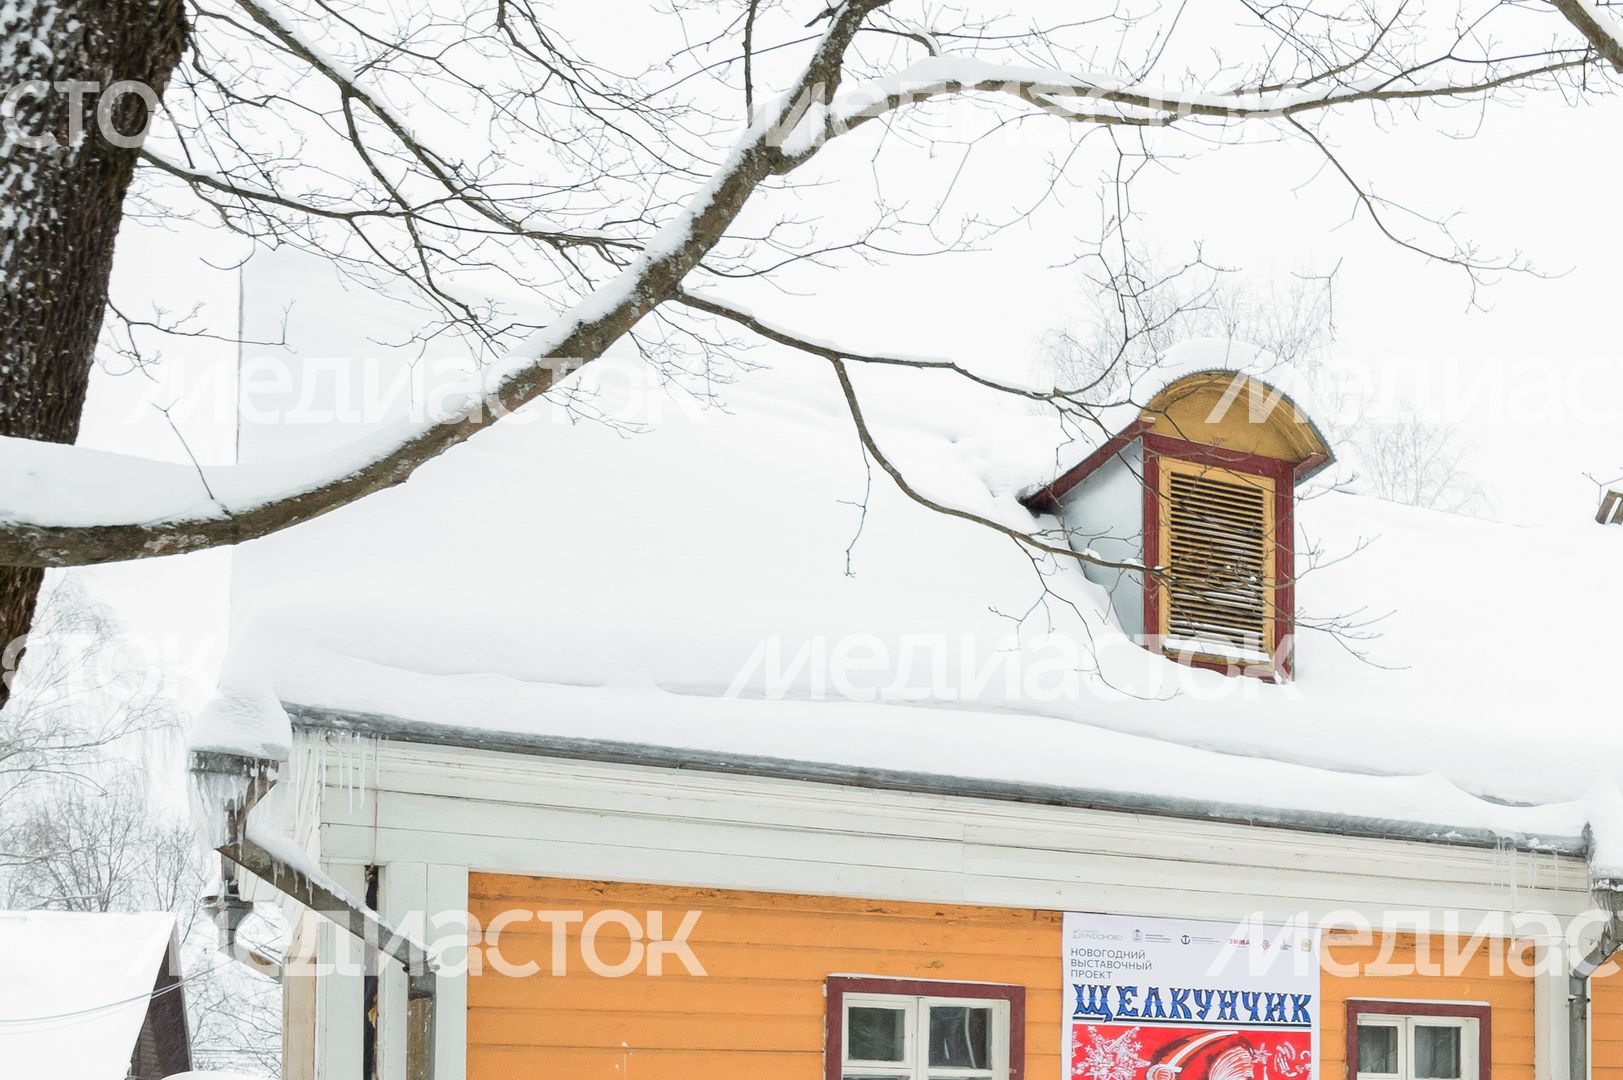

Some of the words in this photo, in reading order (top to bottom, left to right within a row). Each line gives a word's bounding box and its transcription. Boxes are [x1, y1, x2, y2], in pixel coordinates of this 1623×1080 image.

[1071, 948, 1146, 960] НОВОГОДНИЙ
[1071, 959, 1152, 971] ВЫСТАВОЧНЫЙ
[1071, 970, 1113, 979] ПРОЕКТ
[1073, 983, 1312, 1023] ЩЕЛКУНЧИК
